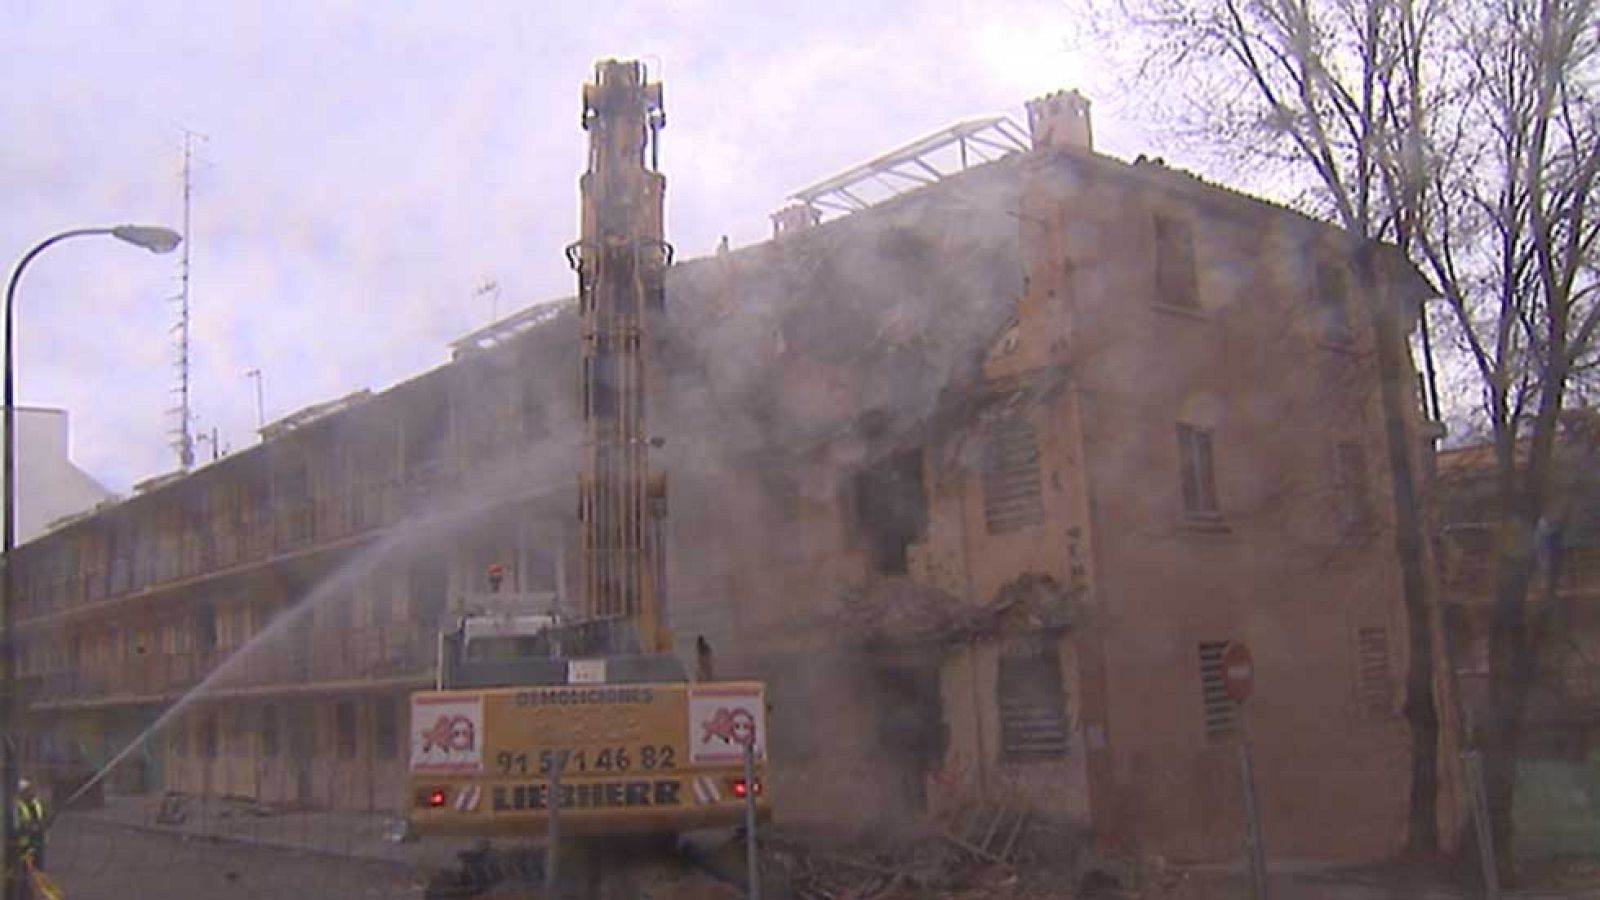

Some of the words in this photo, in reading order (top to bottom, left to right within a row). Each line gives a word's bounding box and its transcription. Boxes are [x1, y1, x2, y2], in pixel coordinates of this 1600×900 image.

[497, 751, 527, 774] 91
[539, 748, 586, 773] 571
[595, 747, 631, 772] 46
[640, 745, 676, 769] 82
[494, 780, 681, 811] LIEBHERR
